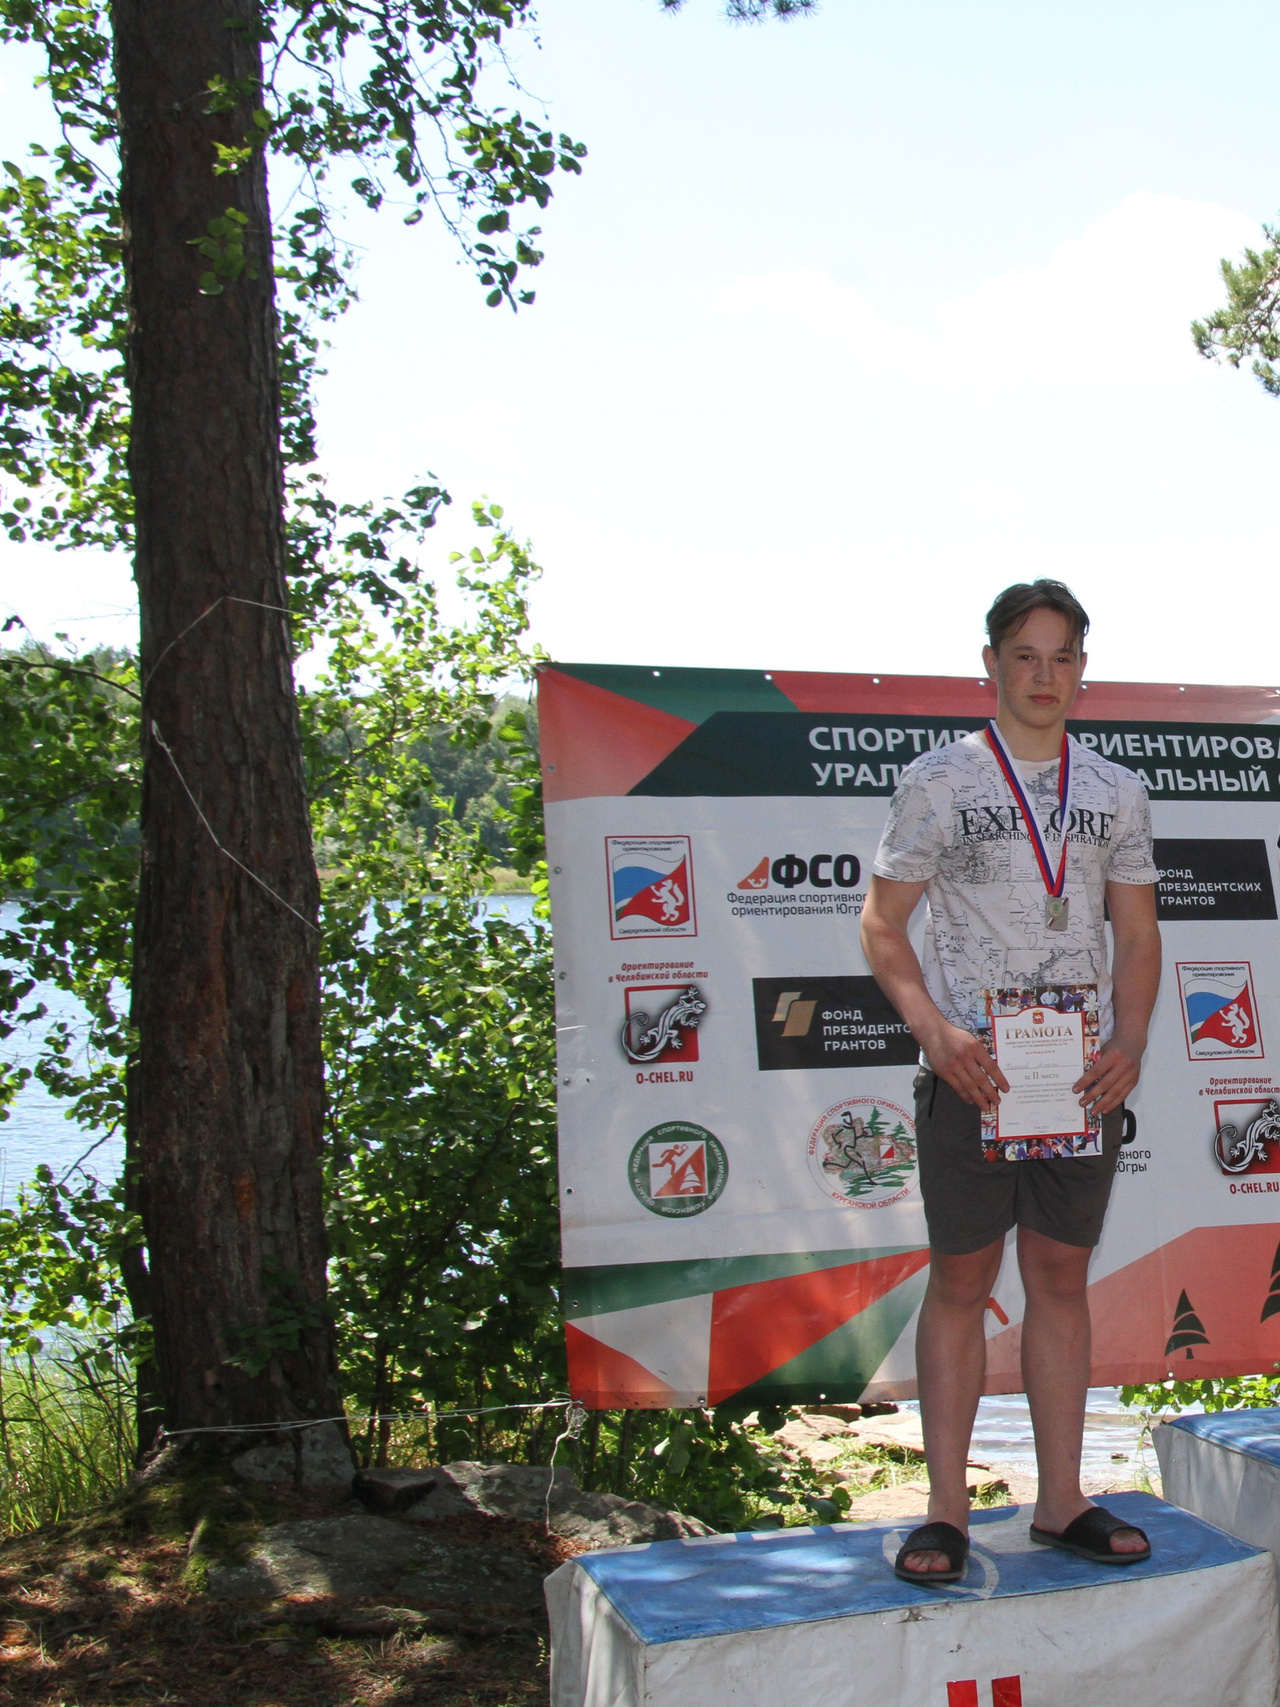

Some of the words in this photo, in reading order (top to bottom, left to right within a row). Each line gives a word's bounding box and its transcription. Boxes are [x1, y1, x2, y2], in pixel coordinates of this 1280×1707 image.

[808, 726, 970, 752] СПОРТИ
[1136, 765, 1270, 792] АЛЬНЫЙ
[958, 805, 1115, 841] EXPORE
[771, 854, 860, 888] ФСО
[1157, 869, 1193, 879] ФОНД
[1158, 882, 1262, 893] ПРЕЗИДЕНТСКИХ
[727, 892, 796, 905] Федерация
[799, 893, 867, 904] спортивног
[1160, 896, 1216, 905] ГРАНТОВ
[731, 906, 833, 917] ориентирования
[836, 903, 863, 917] Югр
[622, 961, 694, 972] Ориентирование
[616, 971, 670, 982] Челябинской
[672, 971, 708, 979] области
[822, 1010, 863, 1021] ФОНД
[823, 1024, 912, 1036] ПРЕЗИДЕНТС
[1005, 1025, 1073, 1040] ГРАМОТА
[824, 1040, 886, 1051] ГРАНТОВ
[636, 1071, 694, 1084] O-CHEL.RU
[1209, 1077, 1272, 1086] Ориентирование
[1205, 1086, 1252, 1095] Челябинской
[809, 1115, 828, 1155] ФЕДЕРАЦИЯ
[827, 1098, 876, 1117] СПОРТИВНОГО
[876, 1099, 916, 1130] ОРИЕНТИРОВ
[632, 1135, 654, 1173] ФЕДЕРАЦИЯ
[657, 1125, 707, 1139] СПОРТИВНОГО
[708, 1140, 725, 1200] ОРИЕНТИРОВАНИЯ
[1229, 1182, 1280, 1194] O-CHEL.RU
[831, 1191, 876, 1209] КУРГАНСКОЙ
[879, 1188, 910, 1208] ОБЛАСТИ
